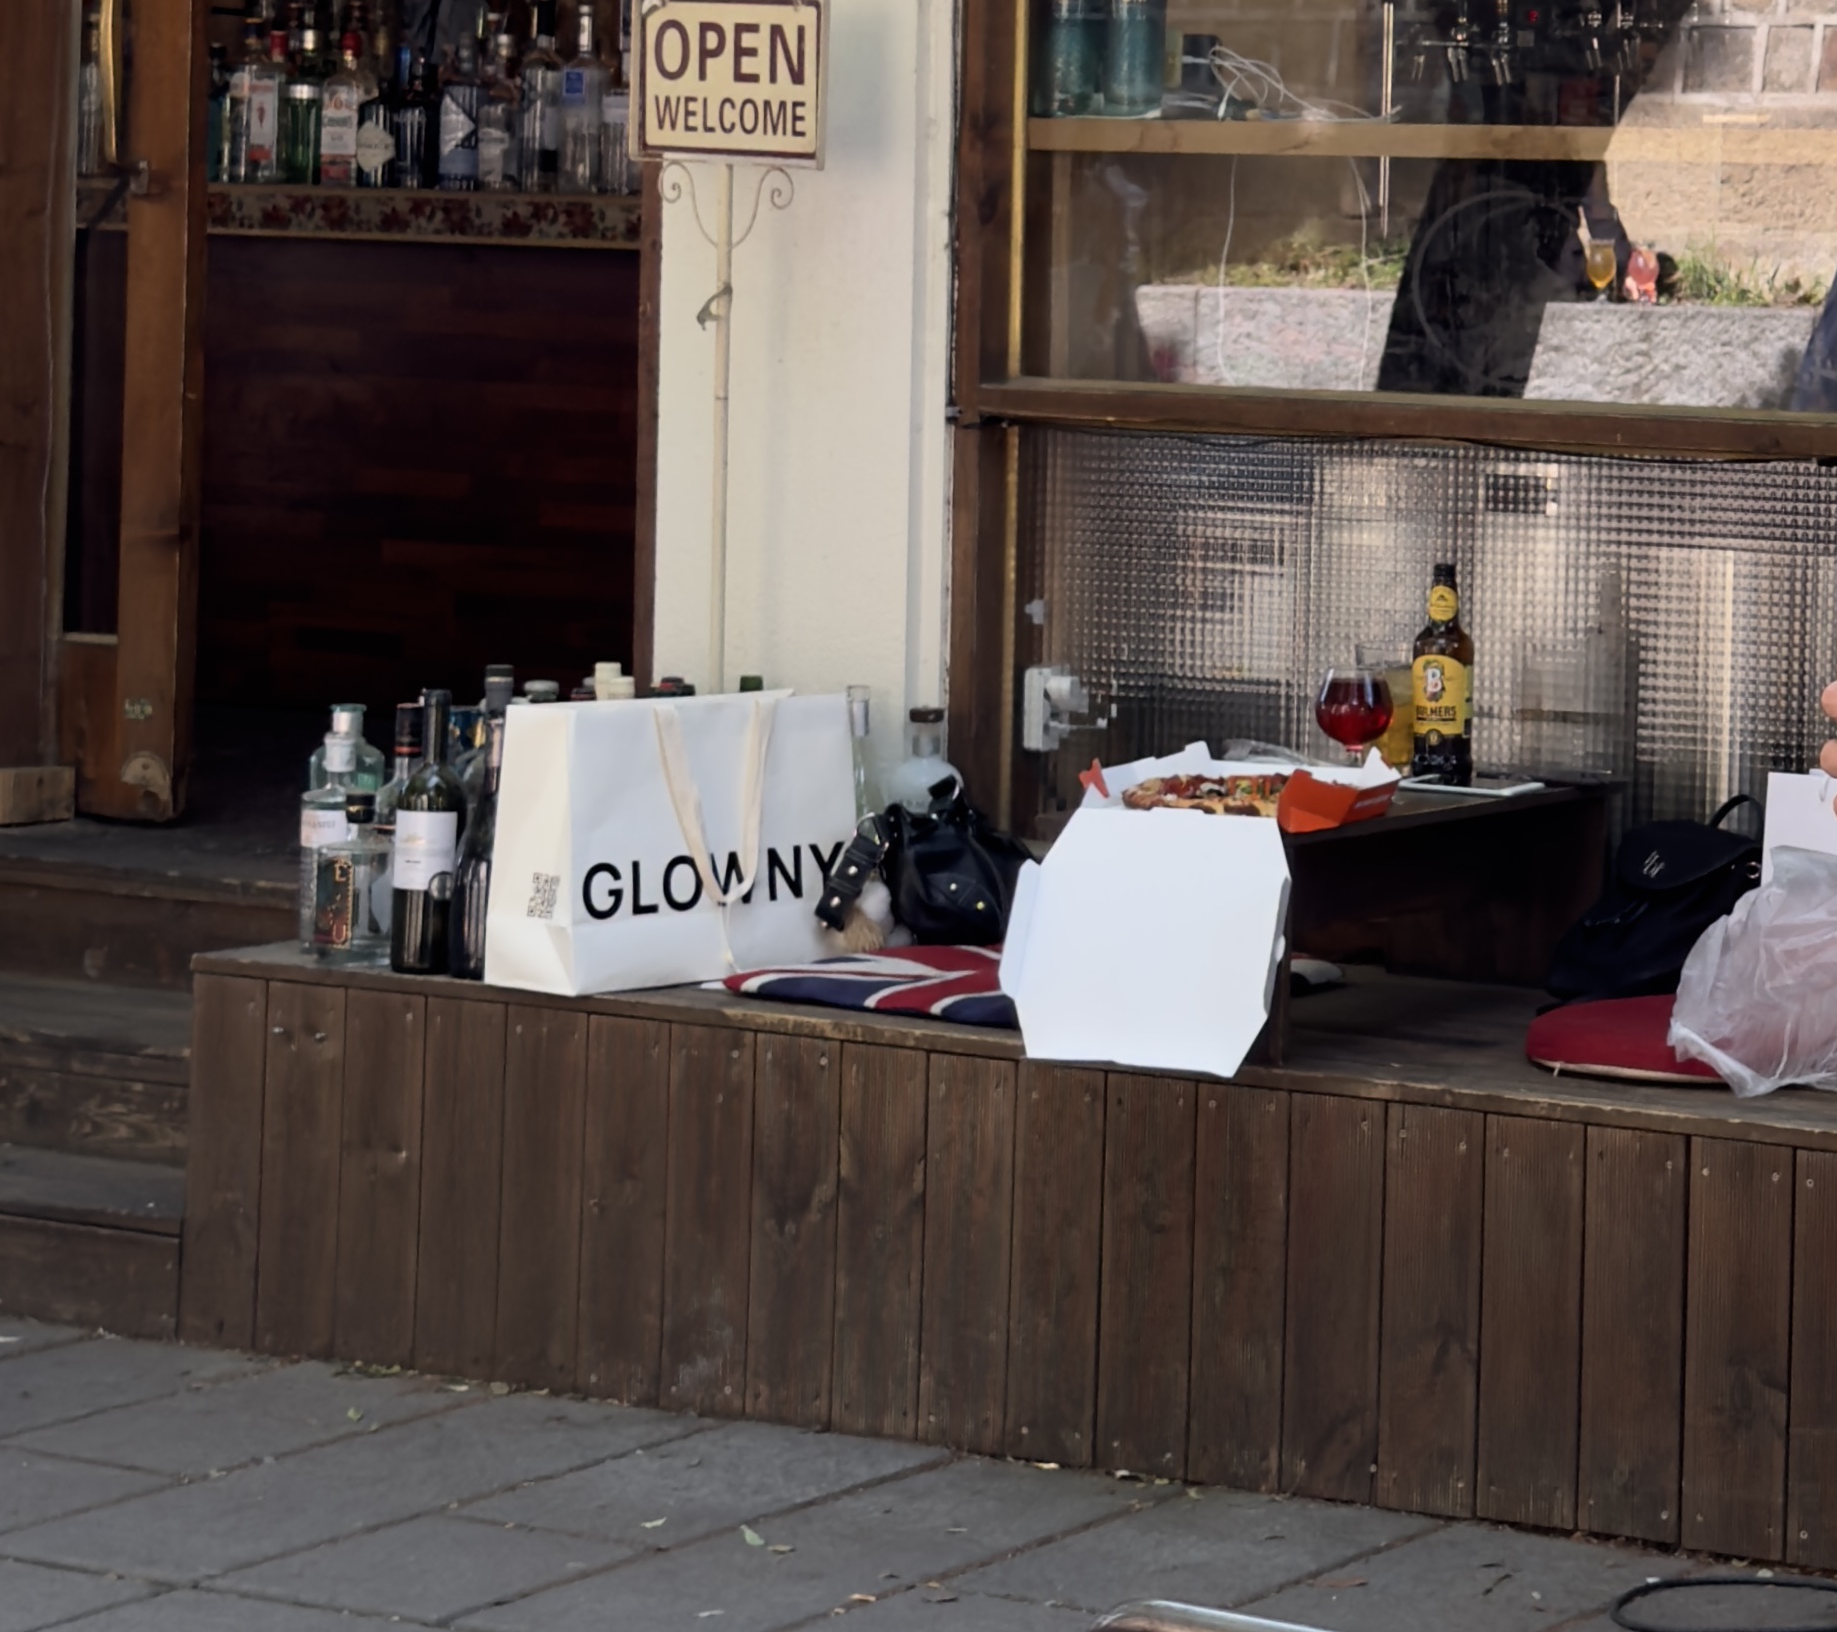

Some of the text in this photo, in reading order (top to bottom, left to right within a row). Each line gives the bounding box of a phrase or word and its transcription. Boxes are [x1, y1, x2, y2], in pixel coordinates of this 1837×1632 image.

[654, 19, 806, 86] OPEN
[655, 94, 807, 138] WELCOME
[582, 840, 847, 921] GLOWNY
